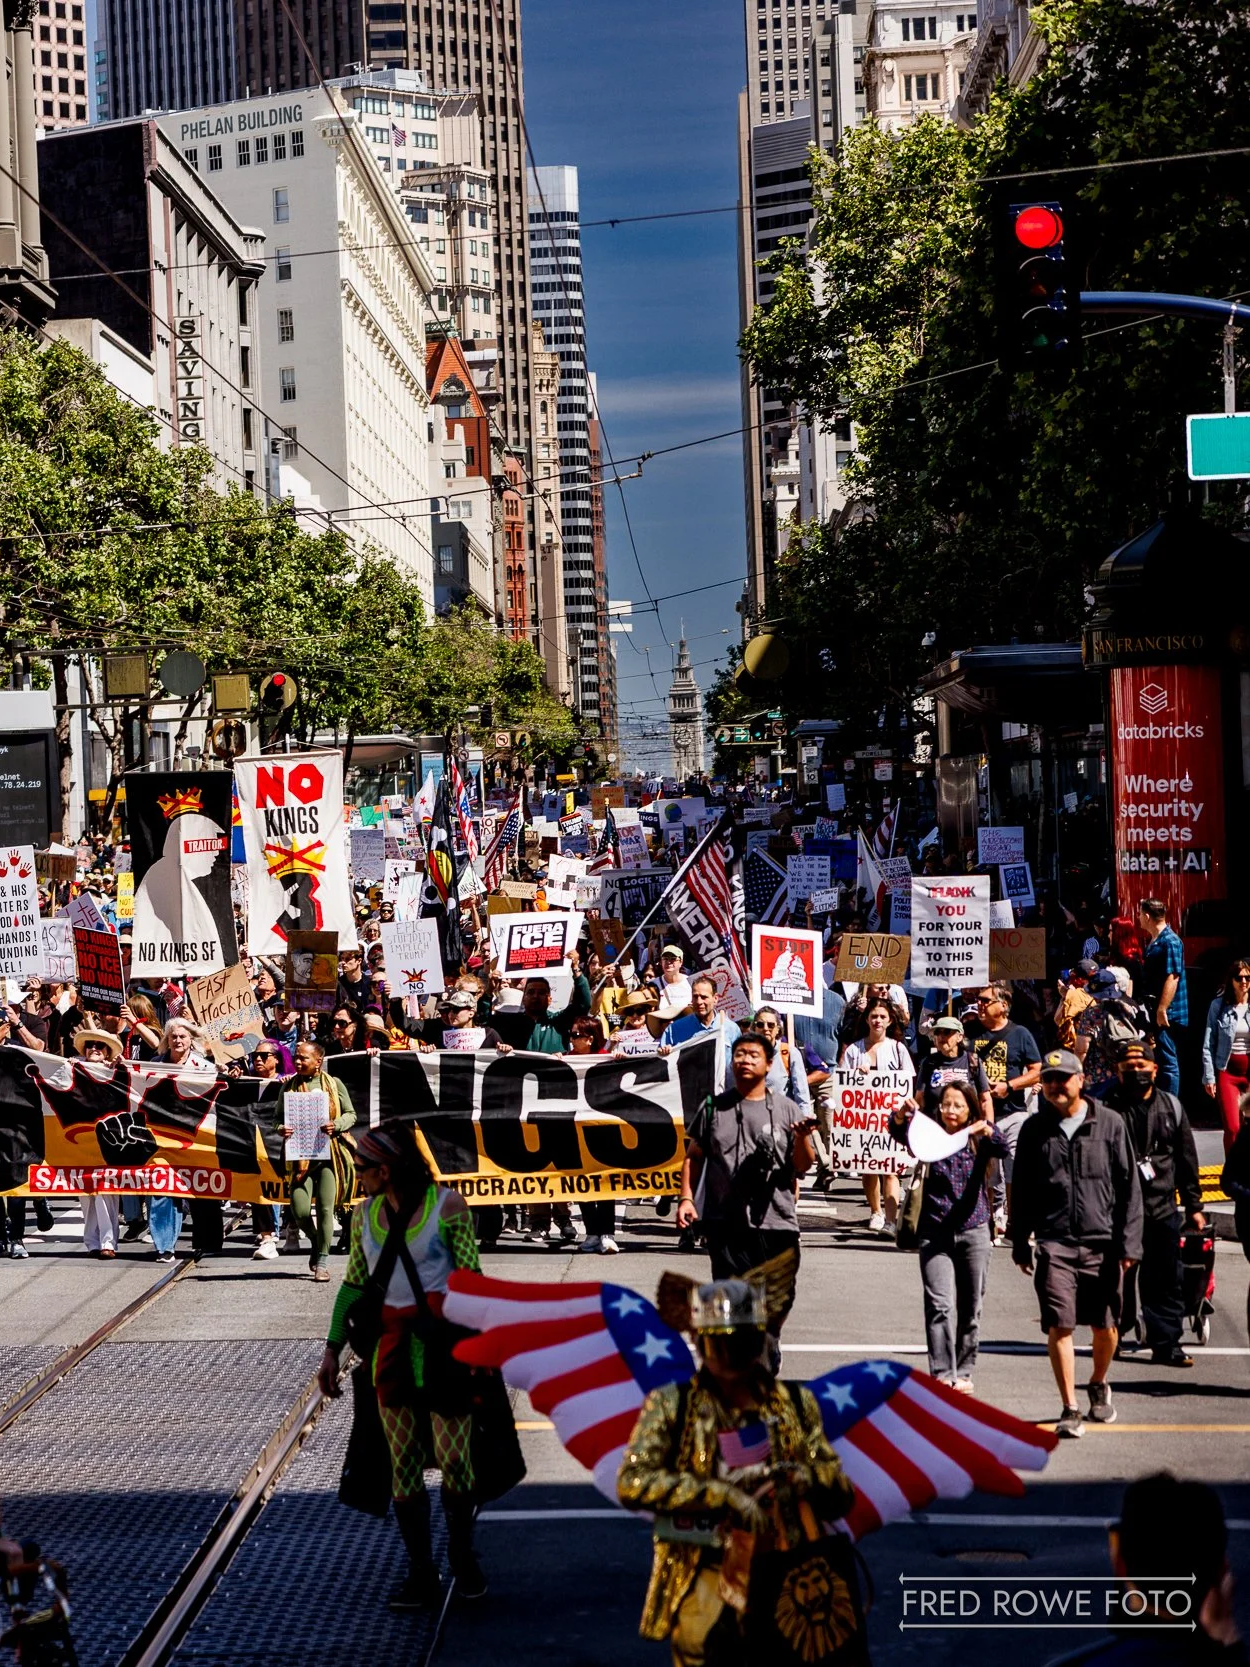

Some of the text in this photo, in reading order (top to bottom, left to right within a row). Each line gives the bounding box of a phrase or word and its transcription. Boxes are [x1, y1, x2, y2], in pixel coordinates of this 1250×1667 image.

[181, 104, 303, 141] PHELAN BUILDING
[1093, 634, 1204, 656] SAN FRANCISCO
[1117, 721, 1204, 741] databricks
[255, 763, 325, 809] NO
[1125, 774, 1194, 794] Where
[1120, 798, 1204, 822] security
[264, 806, 319, 838] KINGS
[617, 826, 636, 837] TOP
[1127, 824, 1193, 843] meets
[187, 839, 225, 853] TRAITOR.
[1121, 851, 1159, 872] data
[1183, 851, 1206, 870] AI
[624, 875, 652, 887] LOCK
[0, 886, 7, 898] &
[11, 884, 27, 896] HIS
[894, 896, 911, 904] POLIT
[814, 901, 837, 912] ELTING
[936, 905, 966, 917] YOU
[21, 914, 35, 926] ON
[396, 921, 424, 935] EPIC
[512, 922, 564, 936] FUERA
[668, 881, 730, 971] AMERIC
[919, 921, 982, 932] FOR YOUR
[75, 929, 117, 948] NO KINGS
[510, 931, 564, 951] ICE
[765, 938, 810, 954] STOP
[849, 936, 902, 958] END
[916, 936, 983, 947] ATTENTION
[990, 931, 1023, 949] NO
[139, 941, 217, 963] NO KINGS SF
[926, 952, 973, 962] TO THIS
[78, 951, 121, 974] NO ICE
[855, 955, 883, 969] US
[992, 953, 1043, 974] INGS
[80, 967, 123, 991] NO WAR
[925, 967, 974, 977] MATTER
[762, 986, 774, 995] THE
[835, 1070, 865, 1087] The
[872, 1074, 910, 1097] only
[841, 1089, 899, 1111] ORANGE
[833, 1109, 889, 1134] MONAR
[832, 1132, 852, 1149] WE
[832, 1150, 909, 1175] Butterfly
[862, 1147, 872, 1159] A
[35, 1164, 226, 1194] SAN FRANCISCO
[441, 1176, 554, 1198] MOCRACY,
[561, 1174, 602, 1194] NOT
[610, 1171, 683, 1192] FASCIS
